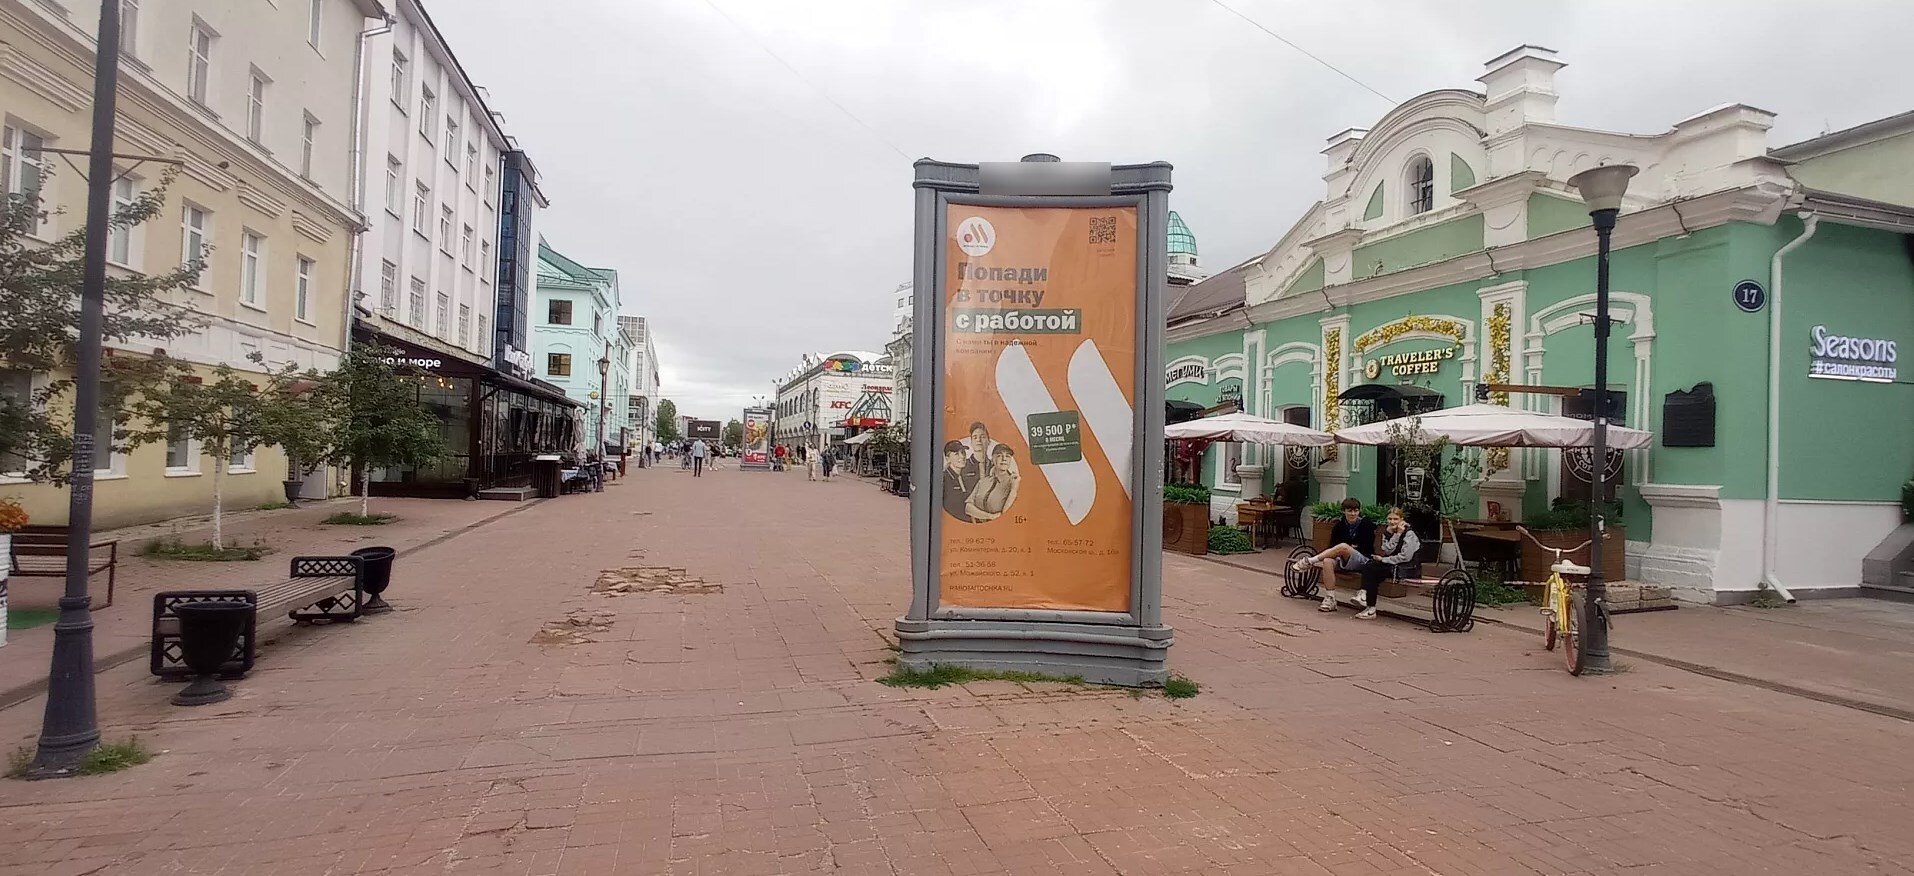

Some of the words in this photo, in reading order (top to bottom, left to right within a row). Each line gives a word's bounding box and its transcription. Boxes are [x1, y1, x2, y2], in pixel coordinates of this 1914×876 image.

[957, 262, 1048, 284] Попади
[957, 289, 970, 303] в
[976, 288, 1045, 307] точку
[1742, 289, 1758, 303] 17
[956, 314, 970, 329] с
[974, 309, 1076, 332] работой
[1811, 325, 1897, 362] Seasons
[397, 357, 406, 366] и
[409, 358, 441, 369] море
[1380, 347, 1454, 366] TRAVELER'S
[1165, 364, 1205, 385] МЕГУМИ
[1392, 361, 1439, 376] COFFEE
[1811, 360, 1897, 379] #салонкрасоты
[830, 400, 852, 409] KFC
[1031, 426, 1043, 437] 39
[1045, 424, 1063, 436] 500
[1014, 515, 1027, 524] 16+
